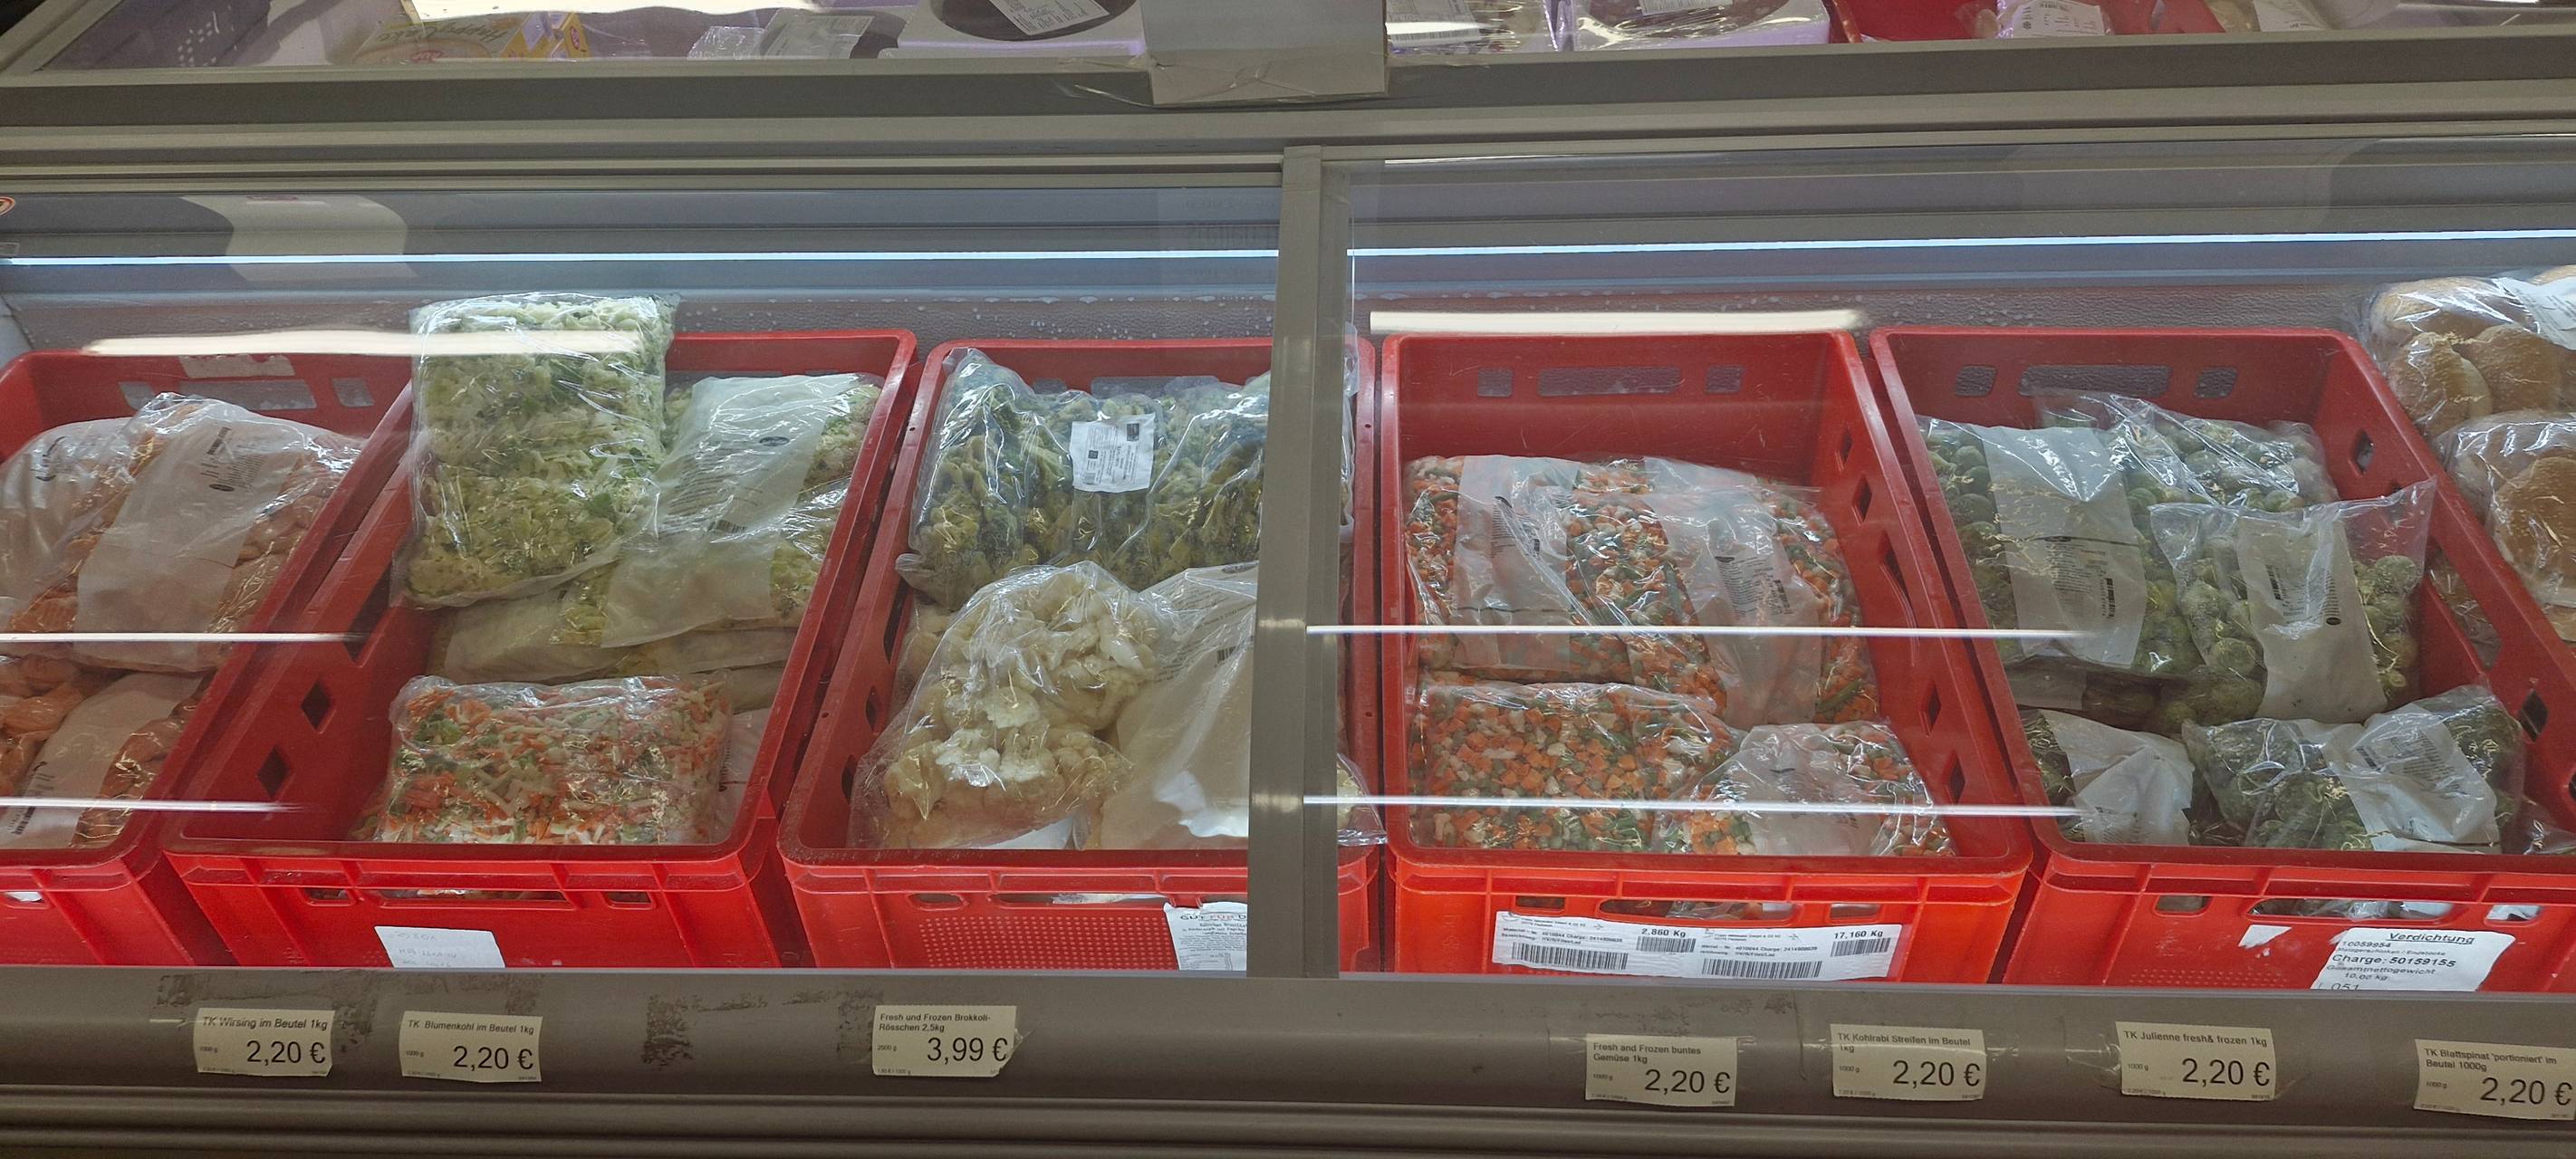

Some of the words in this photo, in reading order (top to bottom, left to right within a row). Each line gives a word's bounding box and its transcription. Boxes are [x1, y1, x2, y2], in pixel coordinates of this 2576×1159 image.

[1673, 930, 1687, 938] Kg
[2389, 933, 2475, 944] Verdichtung
[2331, 954, 2388, 964] Charge:
[2389, 956, 2457, 968] 50159155
[203, 1017, 216, 1026] TK
[219, 1017, 256, 1030] Wirsing
[259, 1019, 272, 1028] im
[274, 1019, 307, 1028] Beutel
[311, 1020, 328, 1030] 1kg
[409, 1020, 419, 1028] TK
[424, 1021, 475, 1031] Blumenkohl
[476, 1023, 486, 1031] im
[489, 1023, 516, 1032] Beutel
[519, 1025, 534, 1035] 1kg
[1838, 1033, 1850, 1041] TK
[1852, 1034, 1889, 1042] Kohlrabi
[1892, 1036, 1927, 1044] Streifen
[1942, 1038, 1971, 1046] Beutel
[2124, 1030, 2138, 1039] TK
[2140, 1032, 2181, 1041] Julienne
[2217, 1036, 2247, 1044] frozen
[2251, 1037, 2267, 1048] 1kg
[246, 1040, 302, 1067] 2,20
[310, 1042, 325, 1064] €
[927, 1037, 984, 1065] 3,99
[992, 1038, 1008, 1061] €
[1593, 1043, 1618, 1051] Fresh
[1620, 1044, 1637, 1052] and
[1671, 1047, 1701, 1055] buntes
[2425, 1049, 2437, 1057] TK
[2440, 1050, 2490, 1060] Blattspinat
[453, 1045, 509, 1071] 2,20
[517, 1049, 533, 1069] €
[1593, 1053, 1629, 1062] Gemüse
[1633, 1055, 1648, 1065] 1kg
[2182, 1058, 2244, 1087] 2,20
[2254, 1061, 2270, 1086] €
[2426, 1059, 2456, 1068] Beutel
[2459, 1061, 2487, 1072] 1000g
[1892, 1059, 1955, 1088] 2,20
[1964, 1062, 1981, 1087] €
[1644, 1068, 1705, 1095] 2,20
[1714, 1071, 1730, 1094] €
[2480, 1077, 2545, 1106] 2,20
[2554, 1082, 2573, 1106] €
